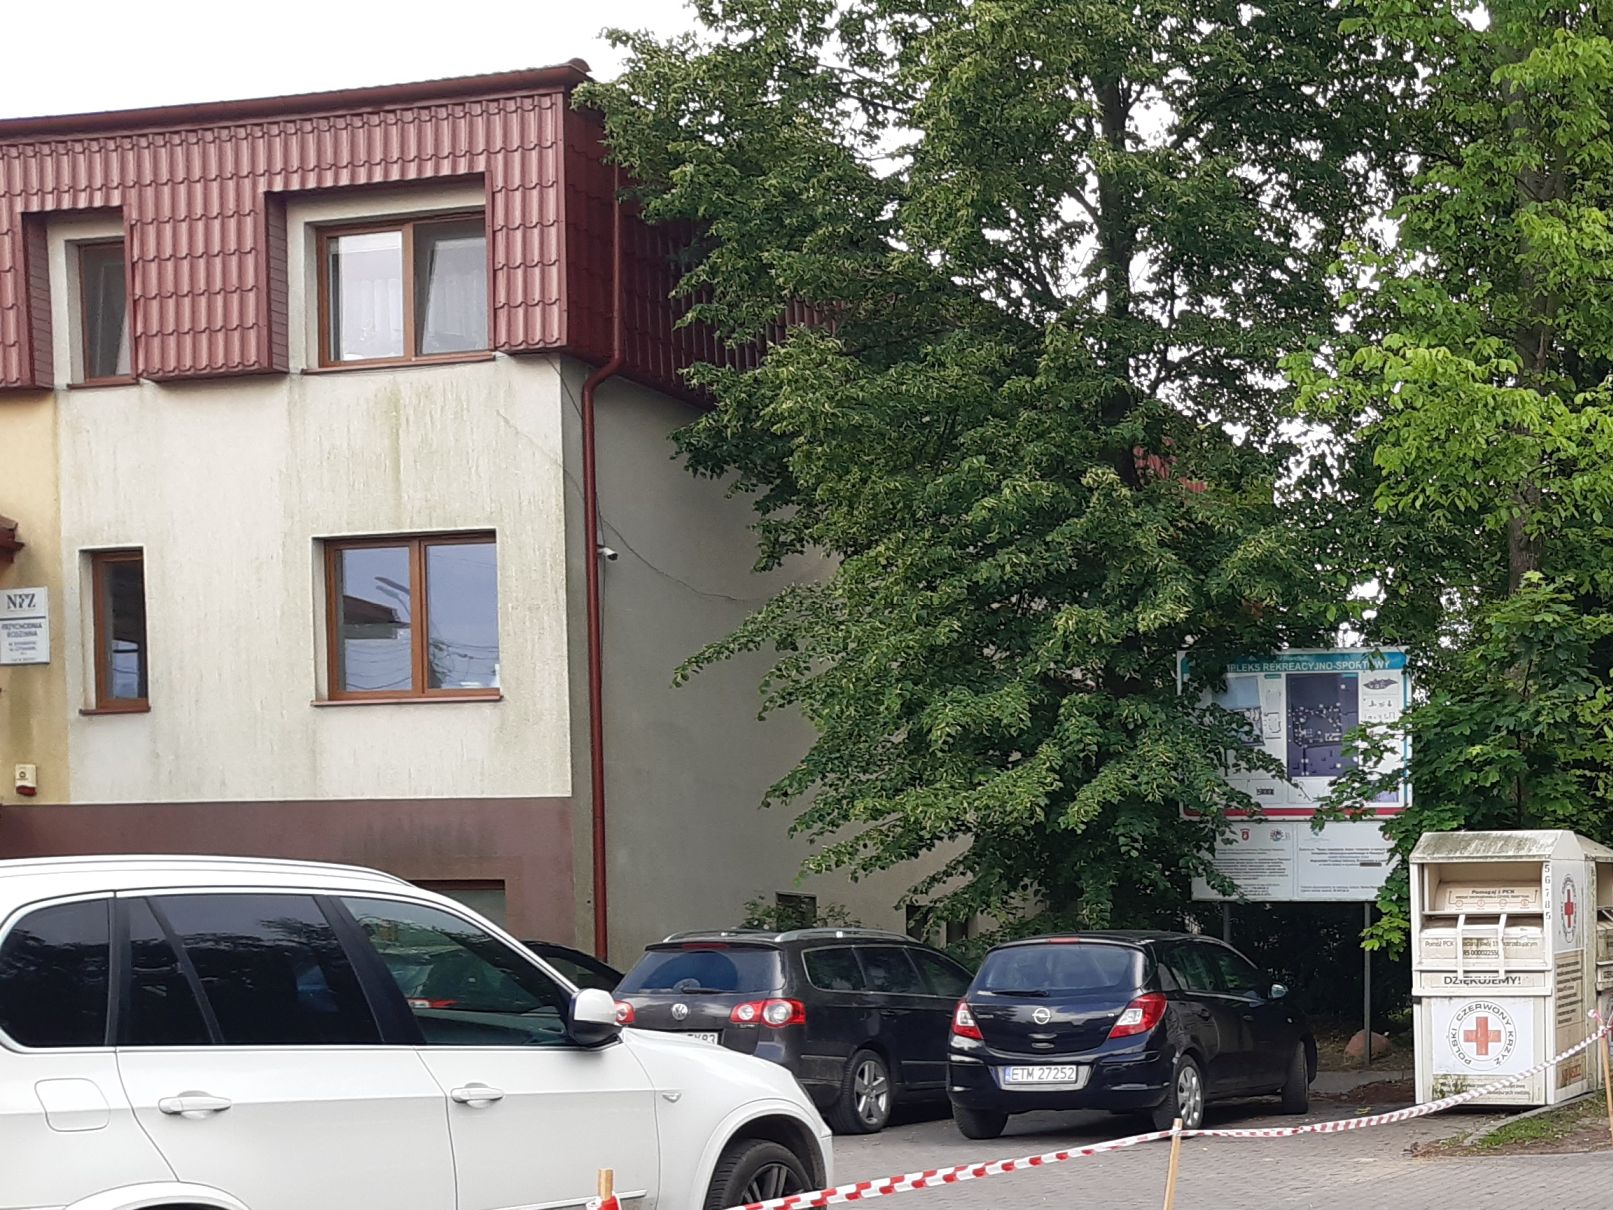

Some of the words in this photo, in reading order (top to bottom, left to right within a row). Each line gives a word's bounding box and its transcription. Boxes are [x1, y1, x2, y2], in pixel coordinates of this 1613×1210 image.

[7, 593, 36, 609] NFZ
[1262, 660, 1391, 673] REKREACYJNO-SPORTWY
[1456, 1003, 1512, 1026] CZERWONY
[1451, 1027, 1472, 1066] POLSKI
[1011, 1067, 1035, 1081] ETM
[1039, 1066, 1075, 1080] 27252
